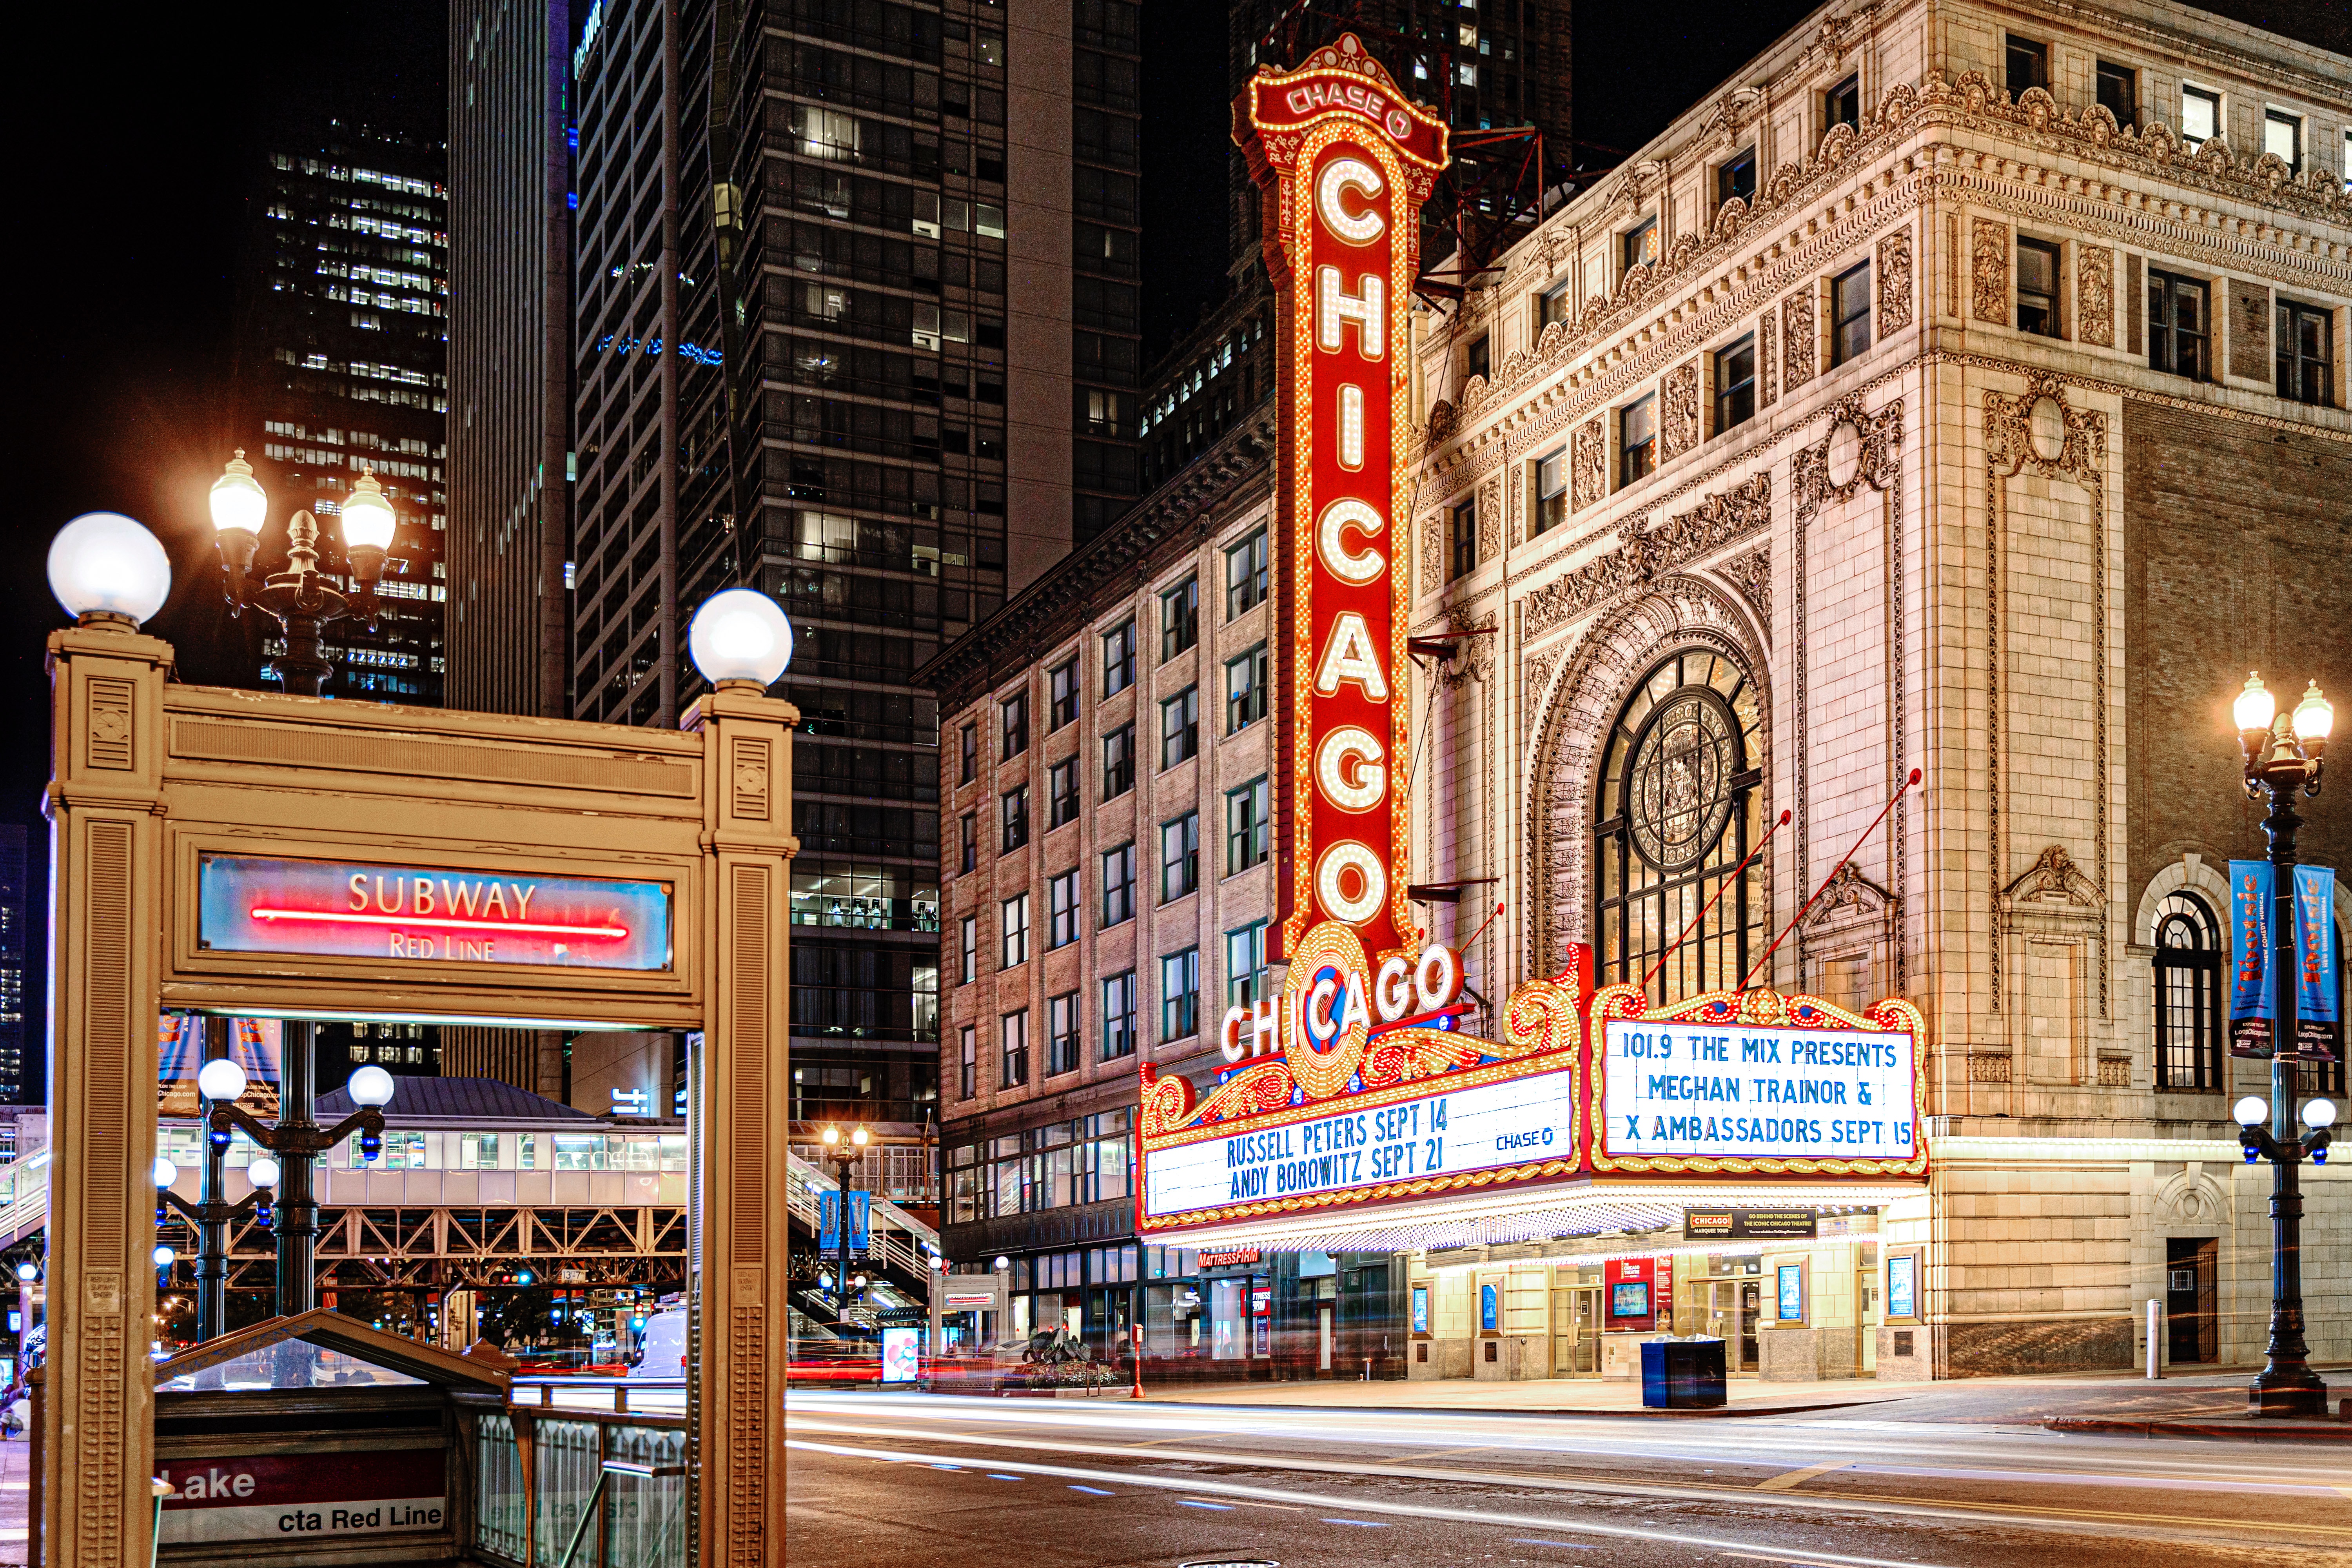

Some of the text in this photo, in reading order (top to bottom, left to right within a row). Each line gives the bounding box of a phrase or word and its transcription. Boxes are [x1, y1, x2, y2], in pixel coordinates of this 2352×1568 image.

[1288, 83, 1385, 119] CHASE
[1315, 159, 1388, 923] CHICAGO
[348, 873, 536, 919] SUBWAY
[390, 933, 495, 961] RED LINE
[2238, 875, 2263, 991] Tootsie
[1221, 943, 1453, 1063] CHICAGO
[1624, 1033, 1896, 1067] 101.9 THE MIX PRESENTS
[1648, 1074, 1871, 1105] MEGHAN TRAINOR &
[1227, 1098, 1448, 1168] RUSSELL PETERS SEPT 14
[1495, 1131, 1540, 1151] CHASE
[1626, 1114, 1911, 1145] X AMBASSADORS SEPT 15
[1230, 1136, 1443, 1200] ANDY BOROWITZ SEPT 21
[160, 1468, 256, 1499] Lake
[279, 1505, 442, 1533] cta Red Line
